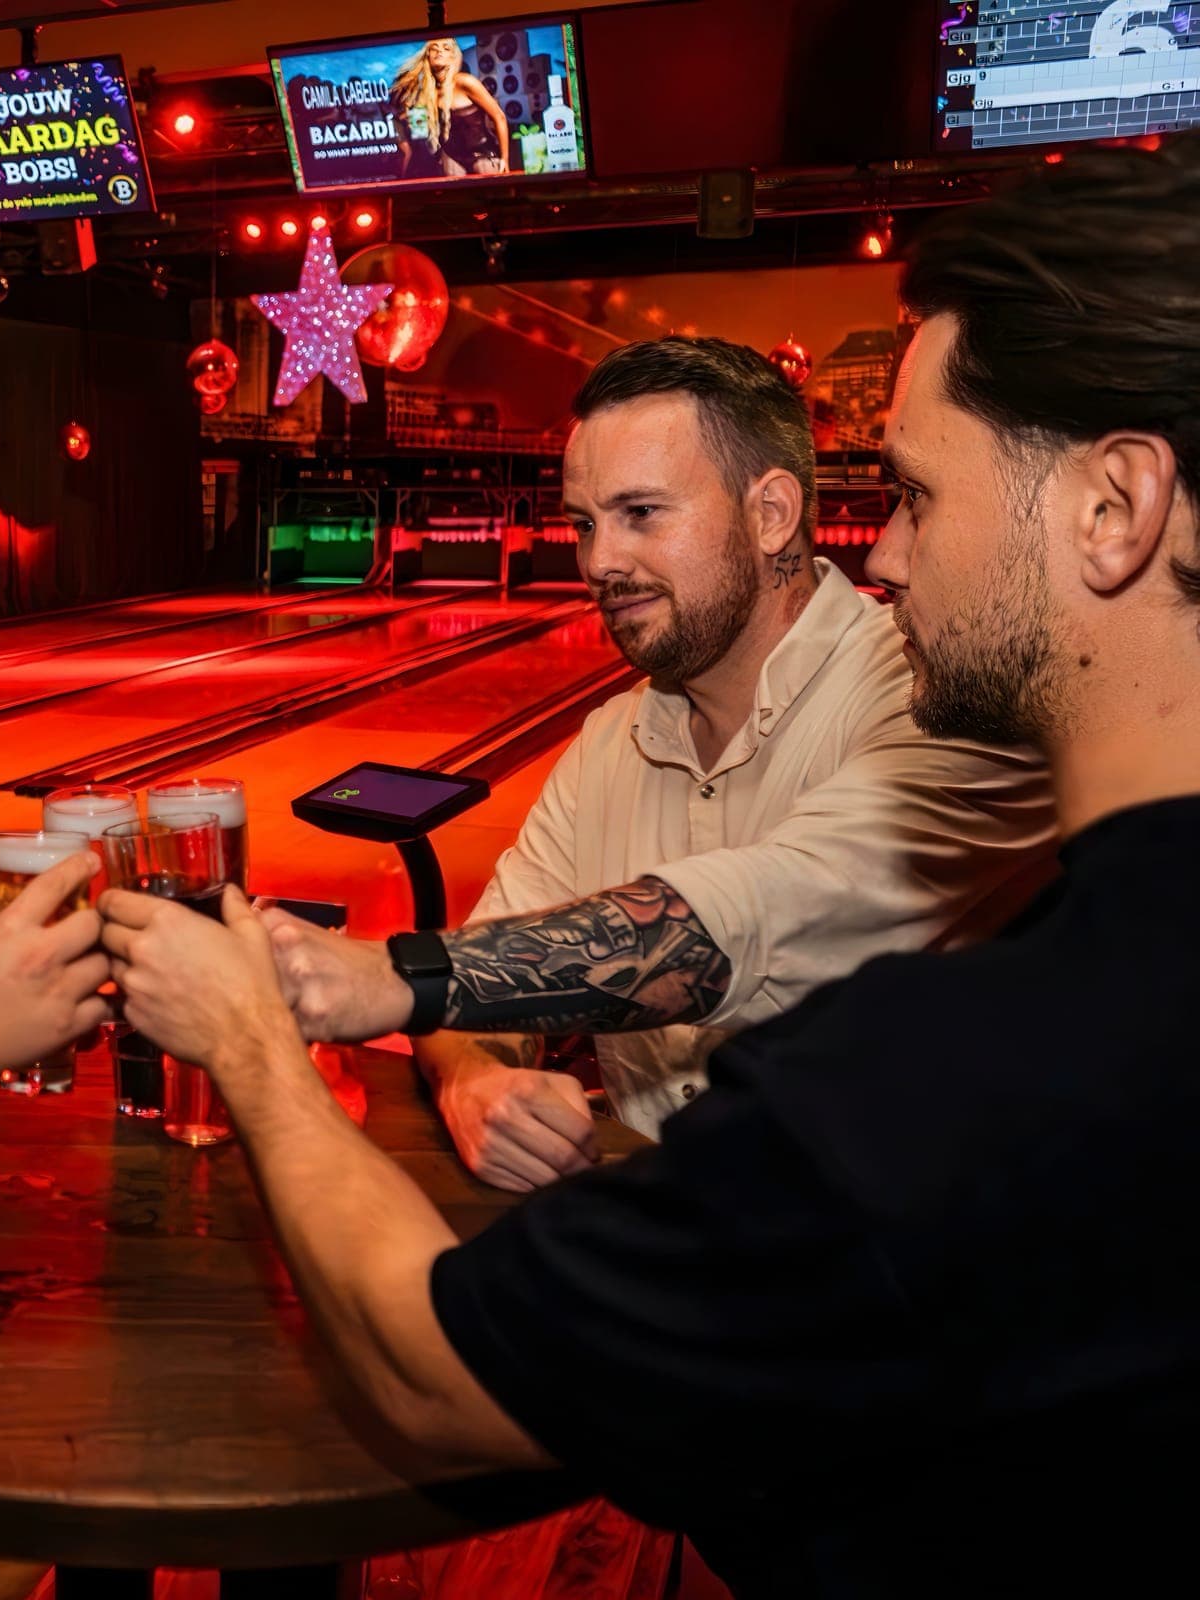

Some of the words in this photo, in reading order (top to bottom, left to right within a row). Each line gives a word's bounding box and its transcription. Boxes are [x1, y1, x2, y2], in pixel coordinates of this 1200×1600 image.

[948, 72, 971, 86] Gjg
[979, 71, 986, 81] 9
[302, 85, 342, 110] CAMILA
[342, 78, 390, 106] CABELLO
[309, 113, 396, 146] BACARDÍ
[380, 143, 398, 154] YOU
[2, 156, 79, 186] BOBS!
